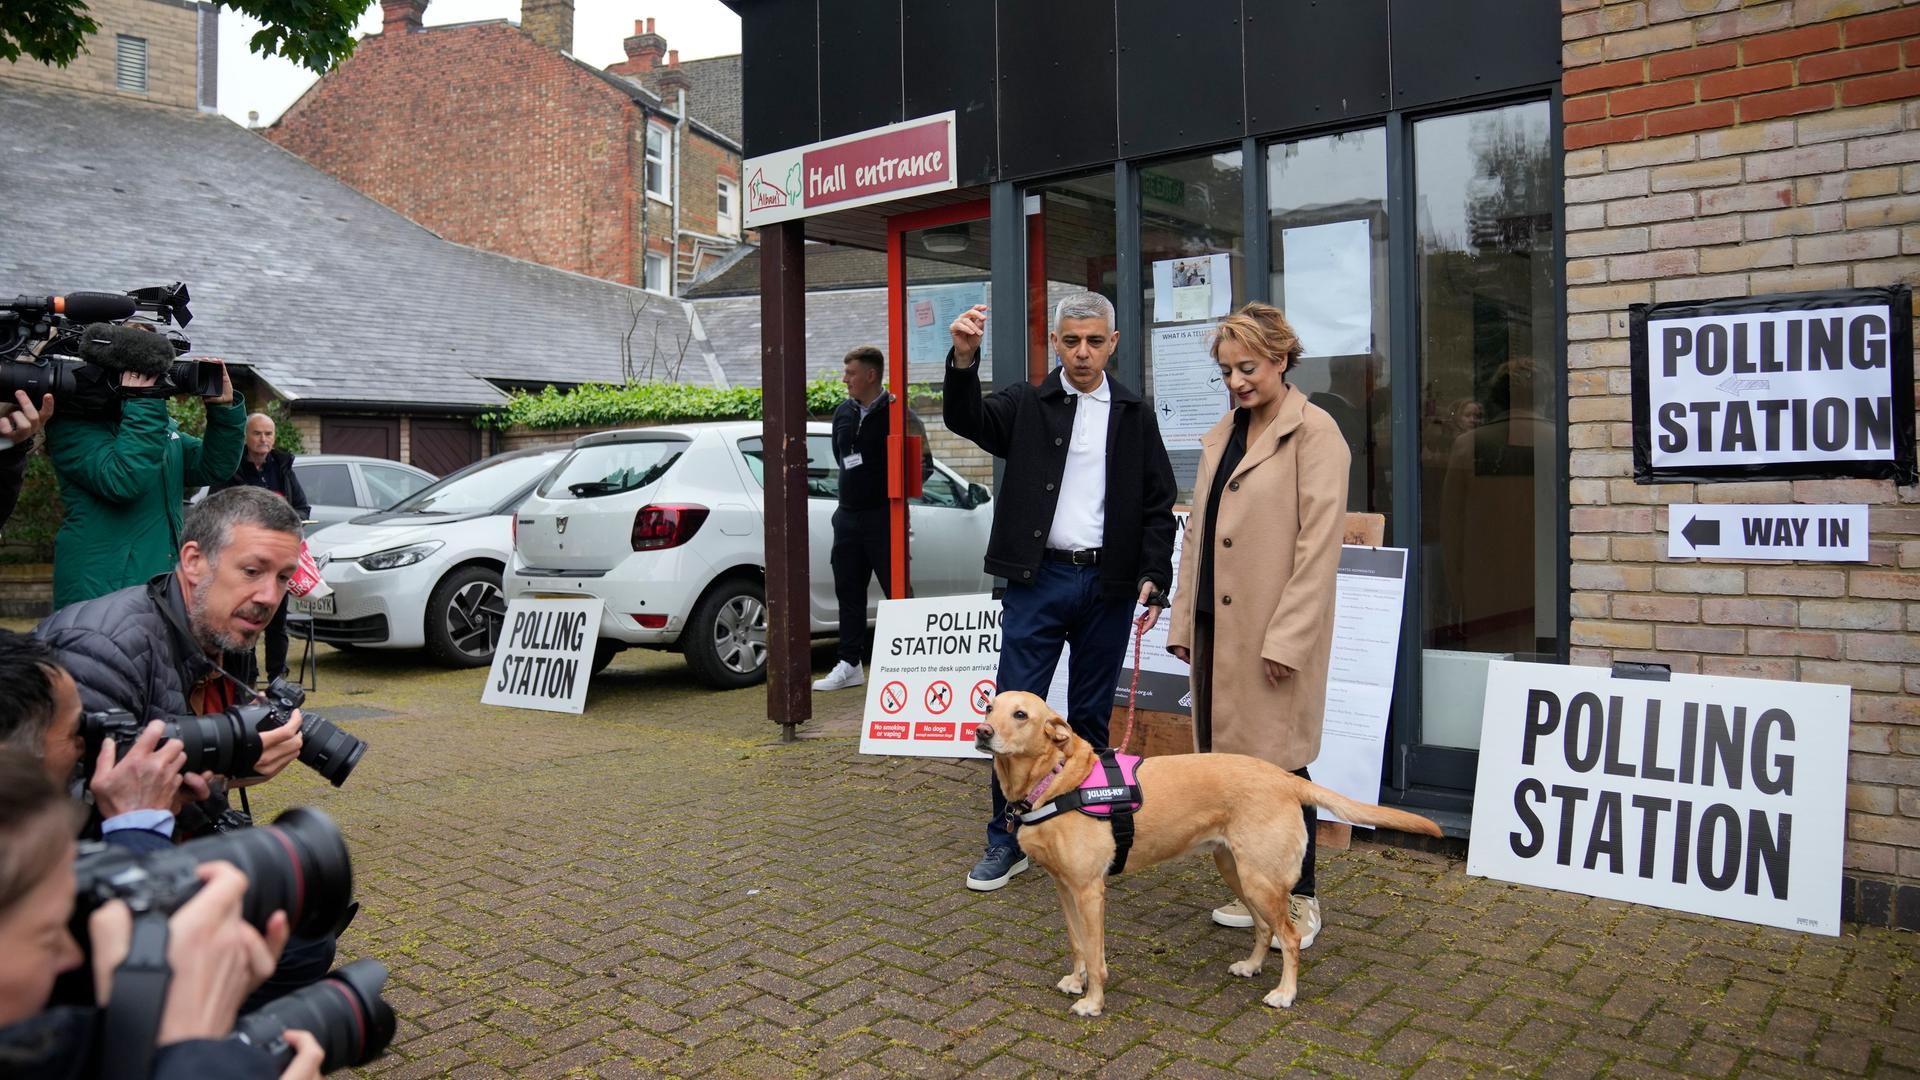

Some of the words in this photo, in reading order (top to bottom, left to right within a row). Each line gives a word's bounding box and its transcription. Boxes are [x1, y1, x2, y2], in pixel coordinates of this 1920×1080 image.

[808, 163, 846, 198] Hall
[855, 150, 943, 188] entrance
[758, 190, 780, 206] Alban's
[1162, 332, 1180, 340] WHAT
[1663, 314, 1886, 377] POLLING
[1658, 396, 1892, 454] STATION
[1742, 517, 1809, 546] WAY
[1818, 518, 1850, 548] IN
[509, 610, 587, 652] POLLING
[891, 635, 971, 656] STATION
[978, 634, 1001, 654] RU
[497, 654, 579, 699] STATION
[901, 666, 919, 674] report
[955, 666, 970, 674] upon
[1521, 688, 1796, 796] POLLING
[1509, 777, 1793, 901] STATION
